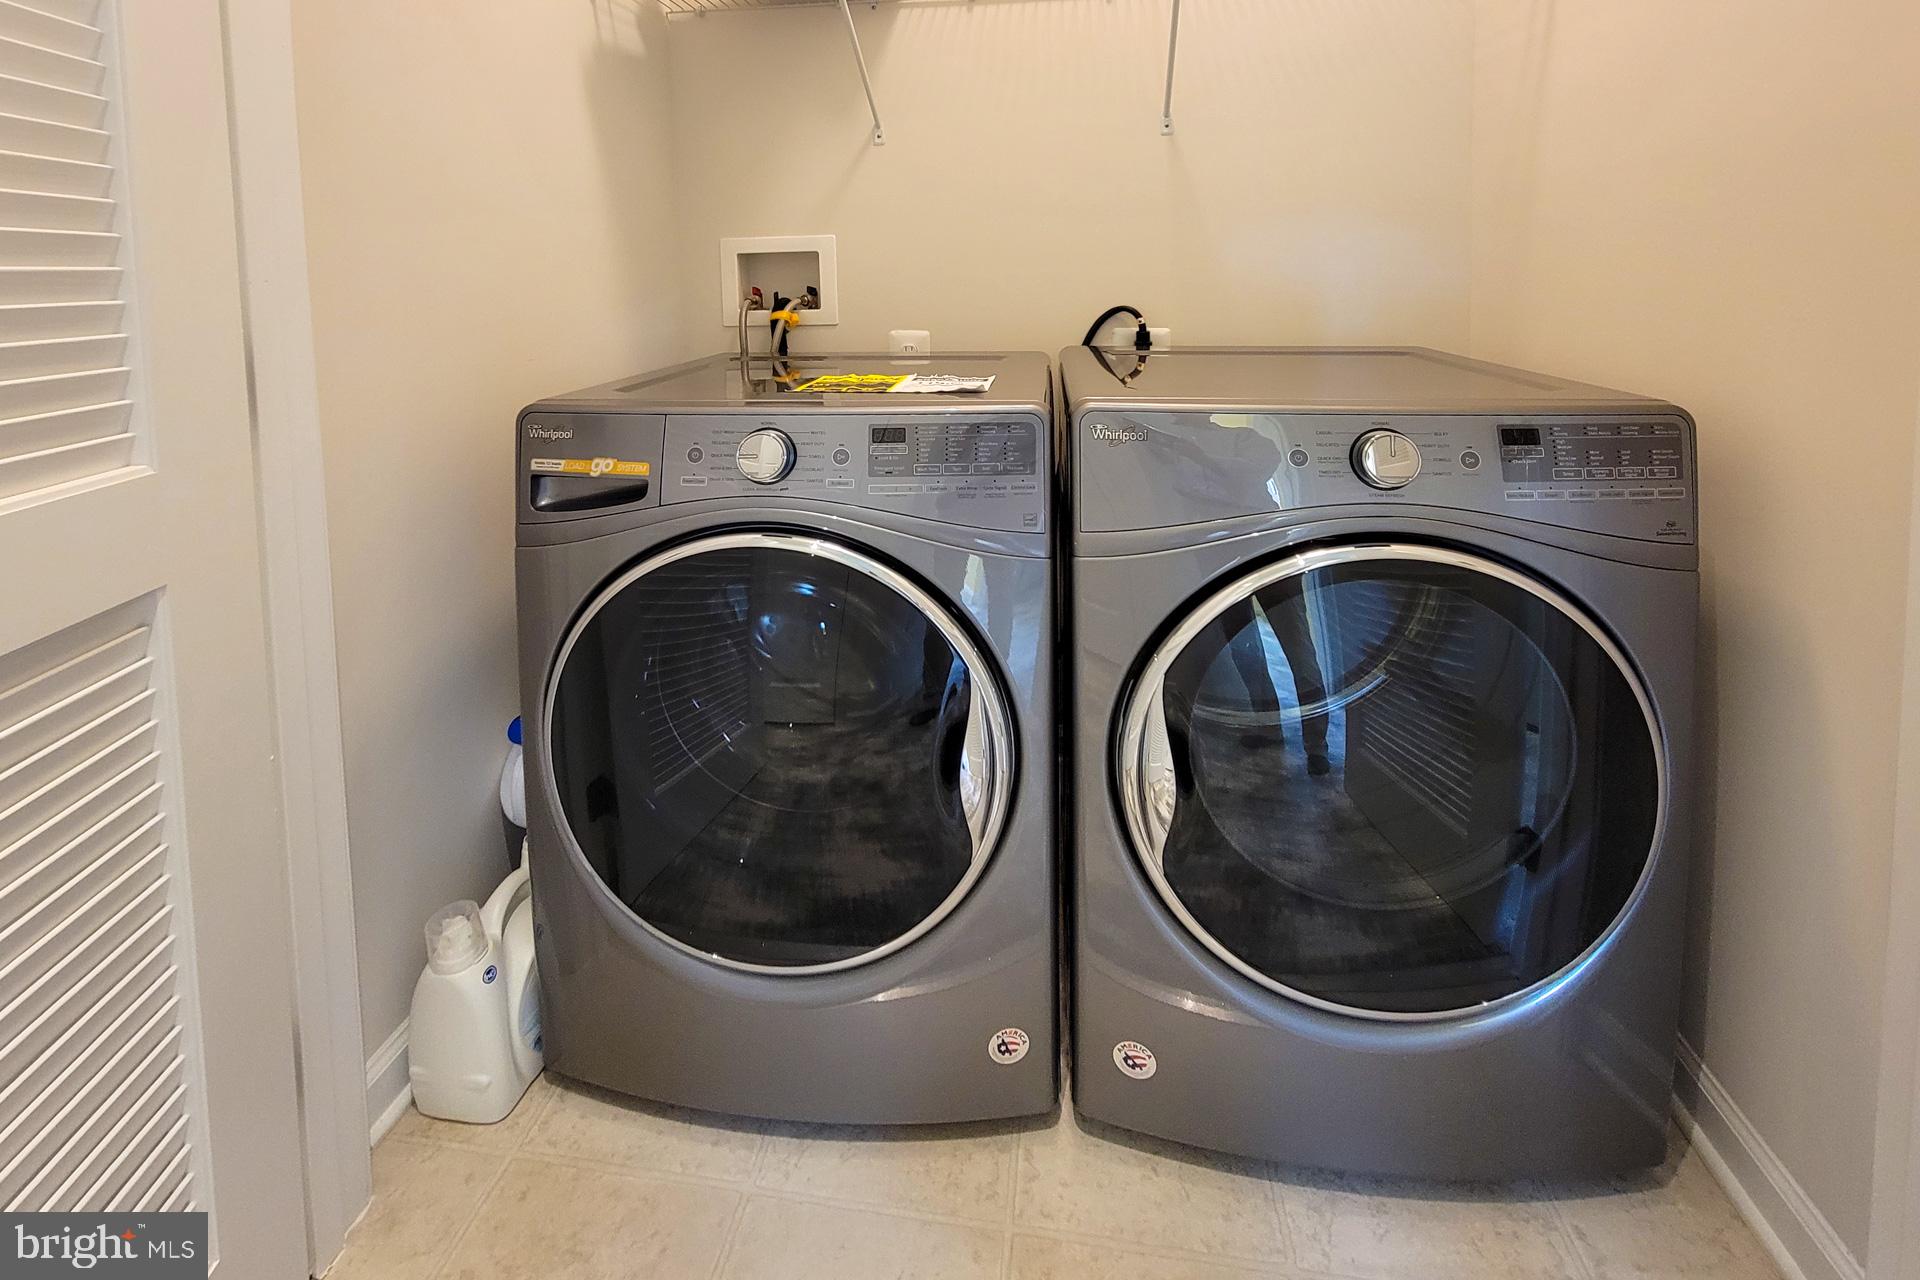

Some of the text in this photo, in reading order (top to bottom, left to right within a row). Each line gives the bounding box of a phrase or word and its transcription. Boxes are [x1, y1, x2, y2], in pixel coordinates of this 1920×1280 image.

[528, 428, 574, 441] Whirlpool
[1091, 428, 1148, 444] Whirlpool
[590, 458, 614, 477] go
[996, 1030, 1027, 1046] AMERICA
[1117, 1043, 1152, 1061] AMERICA
